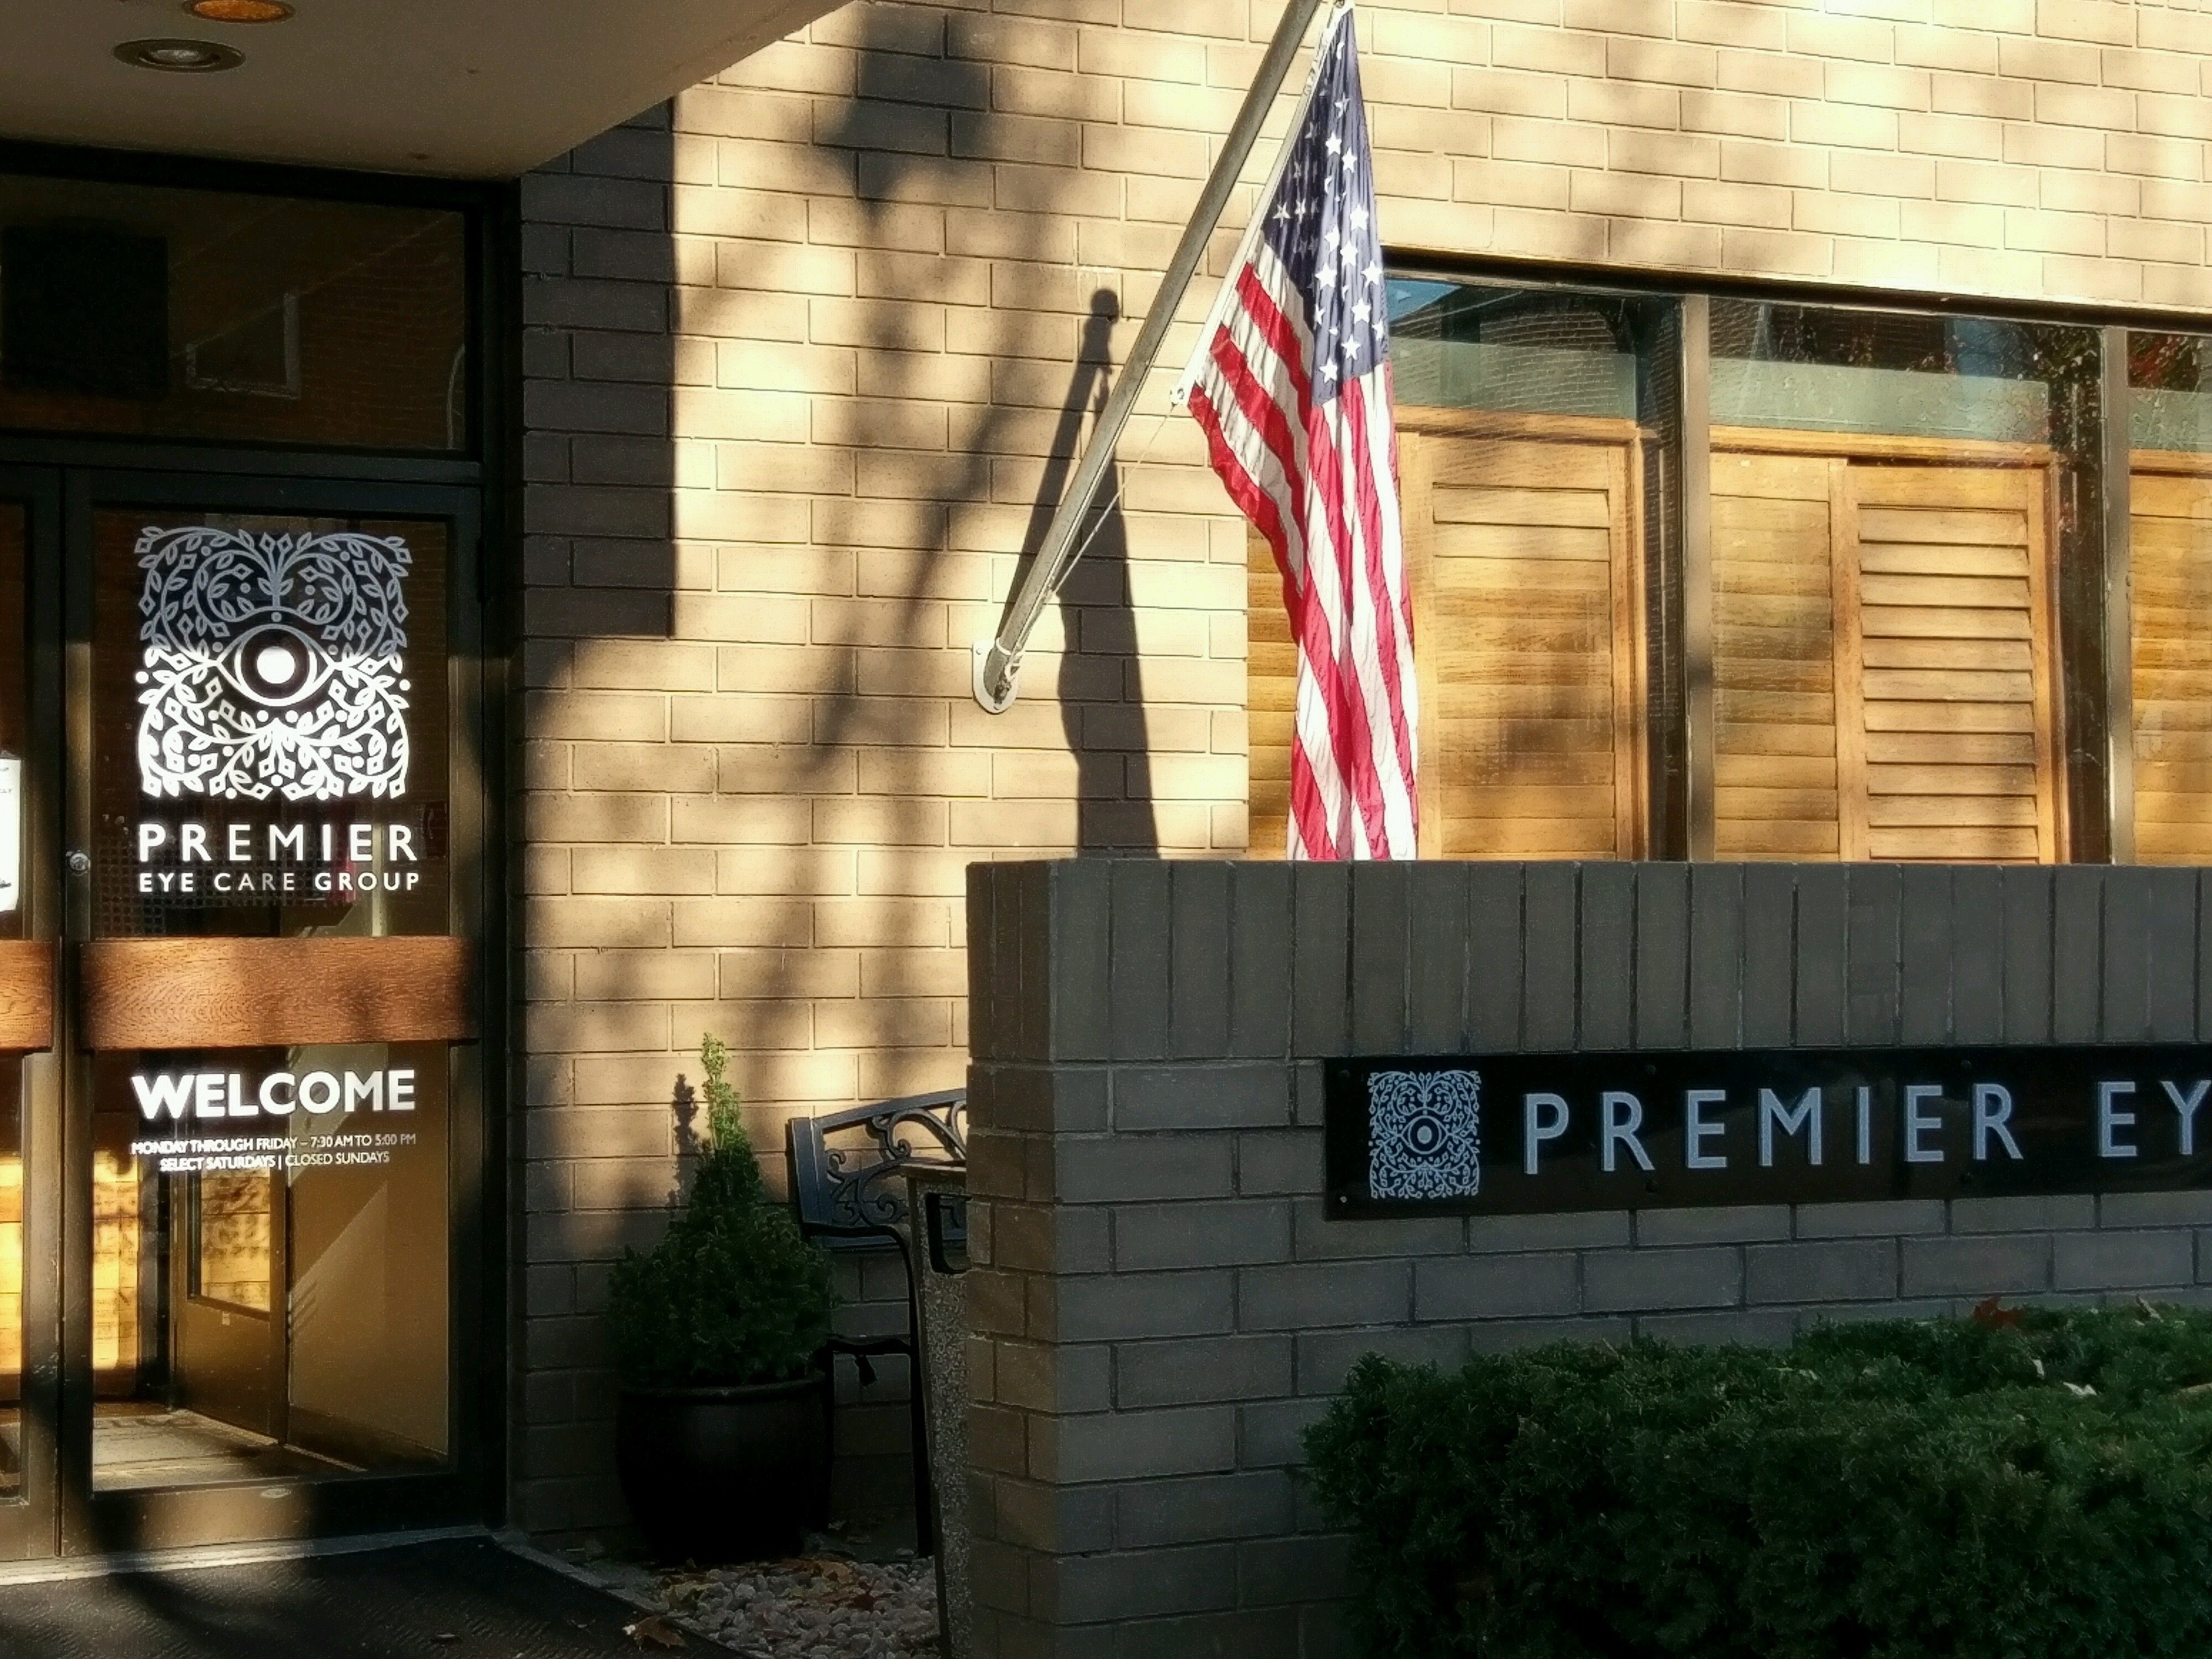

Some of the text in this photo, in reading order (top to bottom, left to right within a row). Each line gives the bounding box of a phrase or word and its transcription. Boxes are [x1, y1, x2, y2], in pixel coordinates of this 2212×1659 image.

[139, 823, 417, 863] PREMIER
[139, 872, 420, 893] EYE CARE GROUP
[131, 1069, 415, 1119] WELCOME
[1522, 1082, 2023, 1175] PREMIER
[130, 1141, 187, 1155] MONDAY
[189, 1138, 253, 1152] THROUGH
[256, 1136, 298, 1150] FRIDAY
[310, 1135, 333, 1148] 7:30
[334, 1135, 353, 1147] AM
[354, 1135, 372, 1147] TO
[375, 1134, 398, 1146] 5:00
[400, 1134, 416, 1145] PM
[160, 1157, 204, 1172] SELECT
[205, 1155, 276, 1170] SATURDAYS
[285, 1153, 333, 1167] CLOSED
[335, 1150, 390, 1165] SUNDAYS
